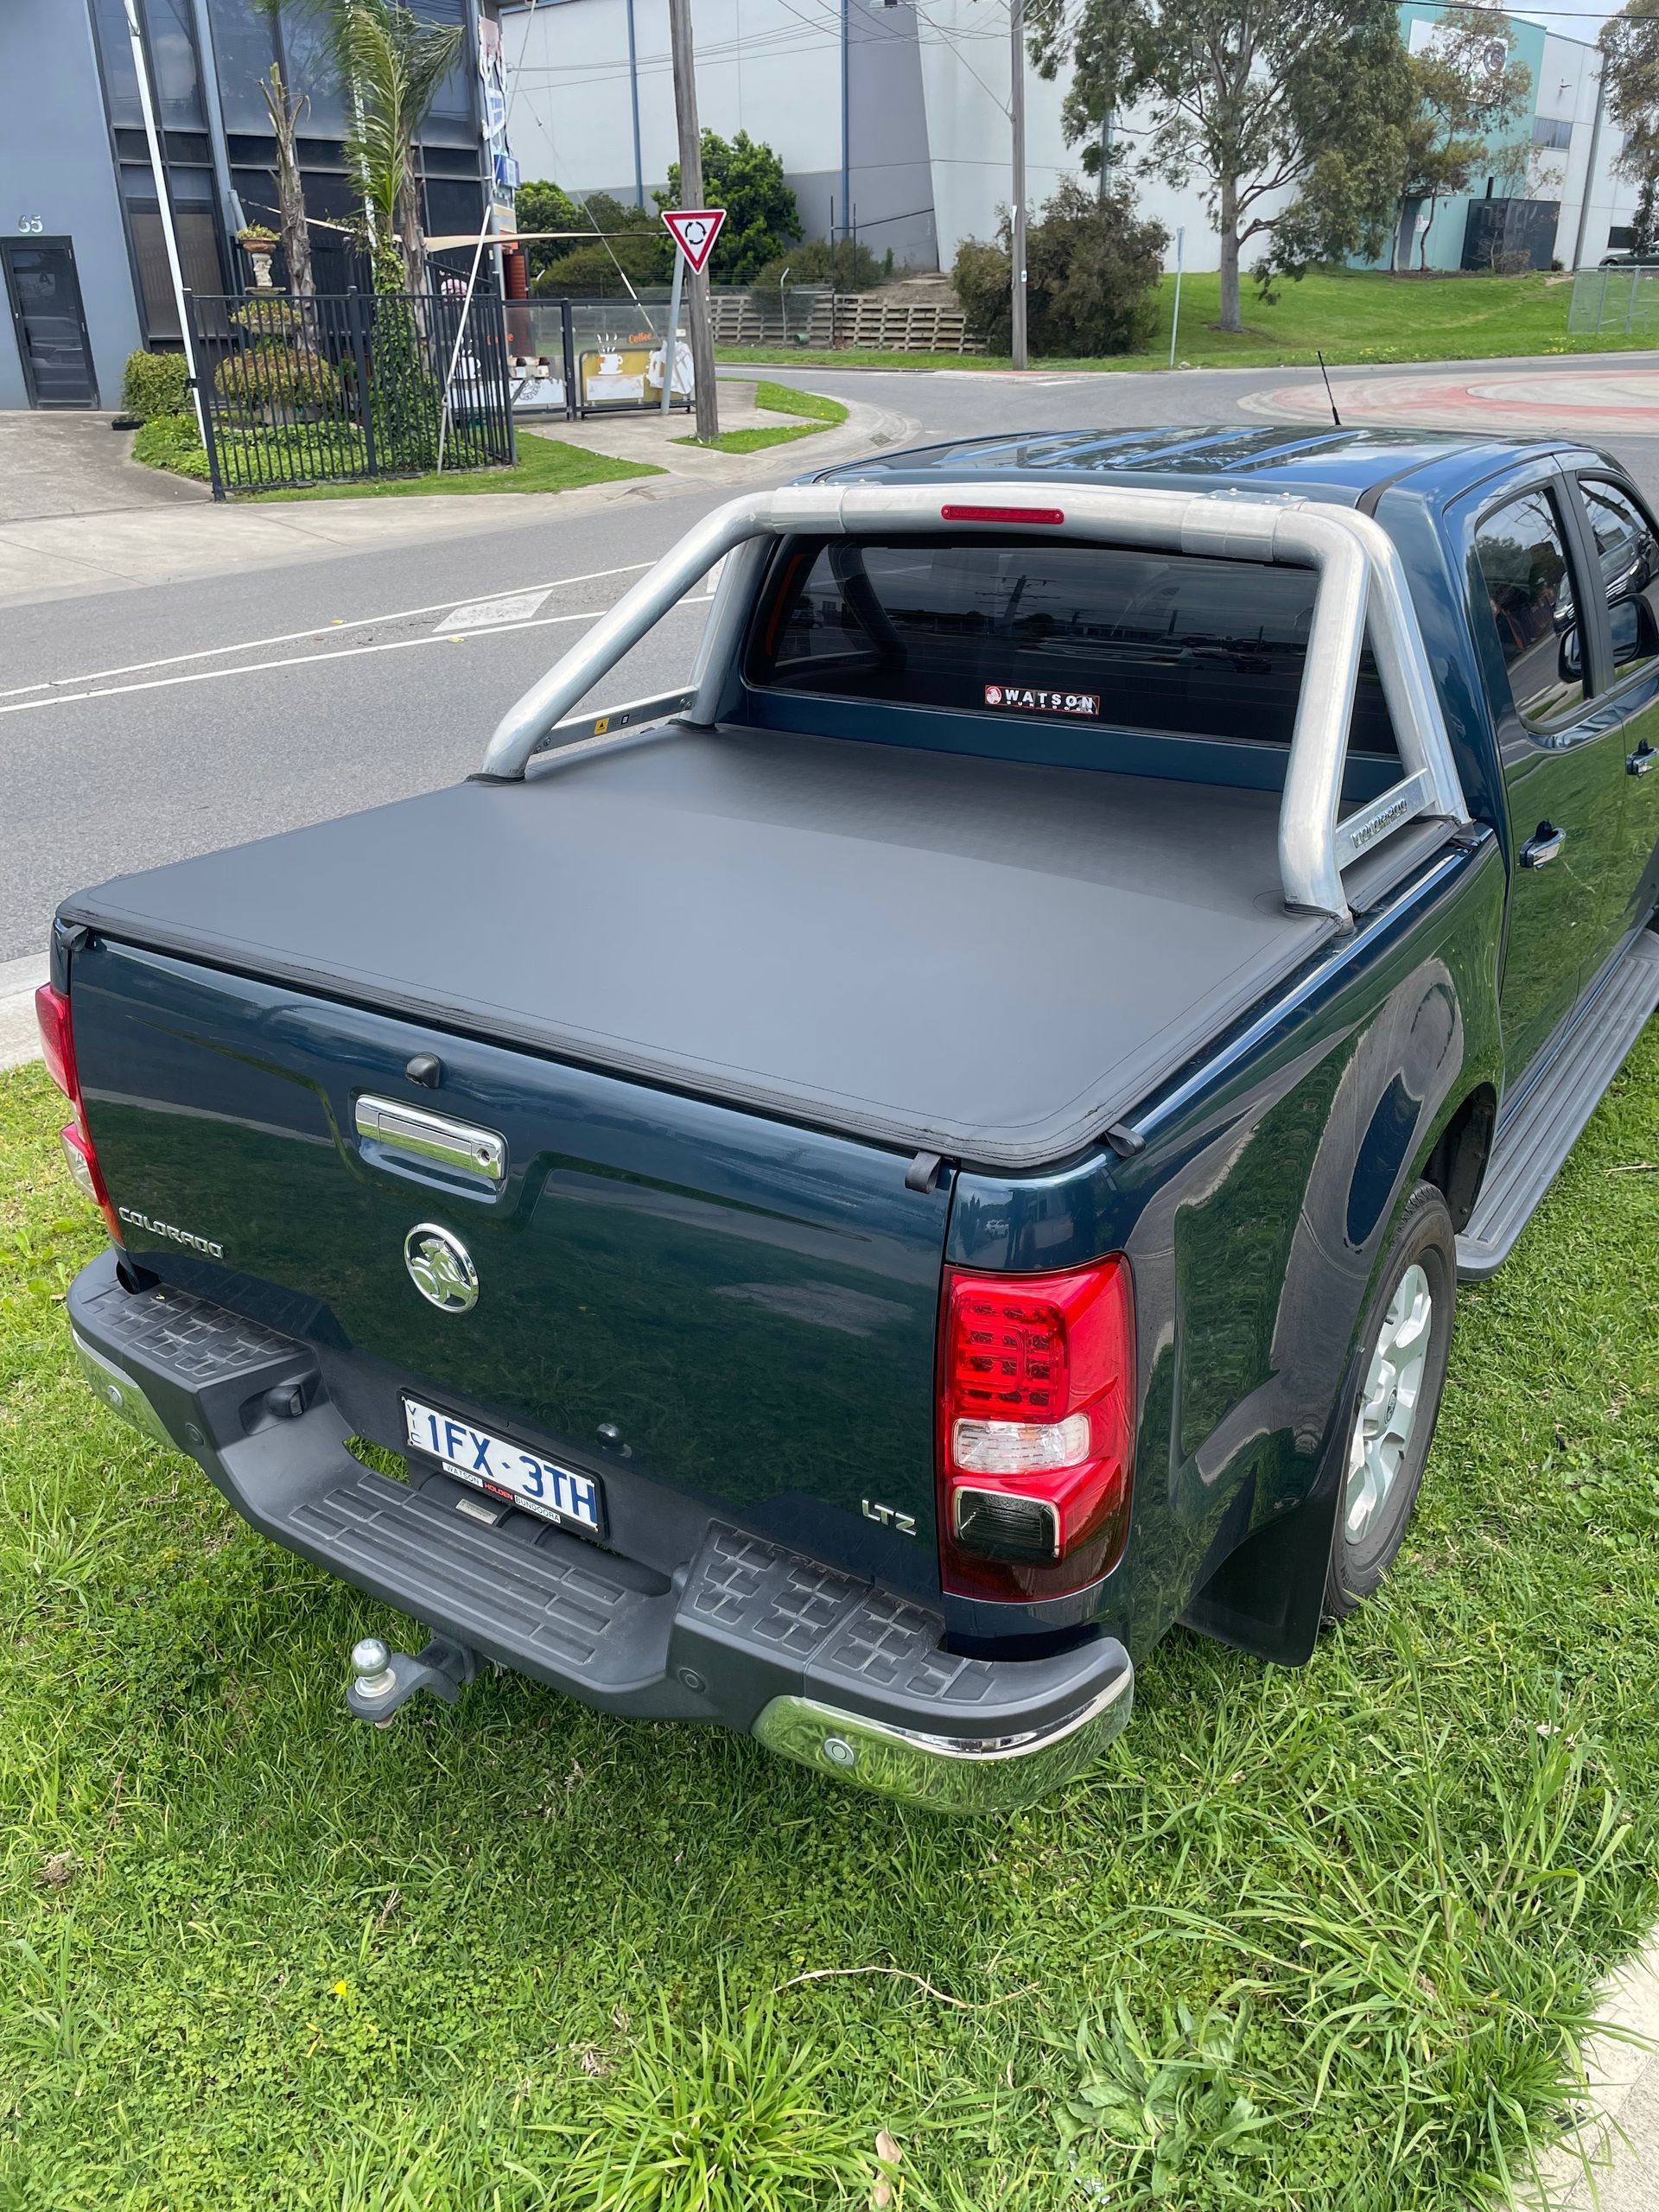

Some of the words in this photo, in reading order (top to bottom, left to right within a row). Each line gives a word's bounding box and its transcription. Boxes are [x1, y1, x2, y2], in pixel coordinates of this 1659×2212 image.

[18, 214, 43, 233] 65
[1005, 689, 1093, 709] WATSON
[119, 1206, 224, 1259] COLORADO
[407, 1404, 422, 1445] VIC
[446, 1465, 480, 1485] WATSON
[484, 1482, 513, 1501] HOLDEN
[515, 1495, 561, 1523] BUNDOORA
[861, 1499, 917, 1536] LTZ
